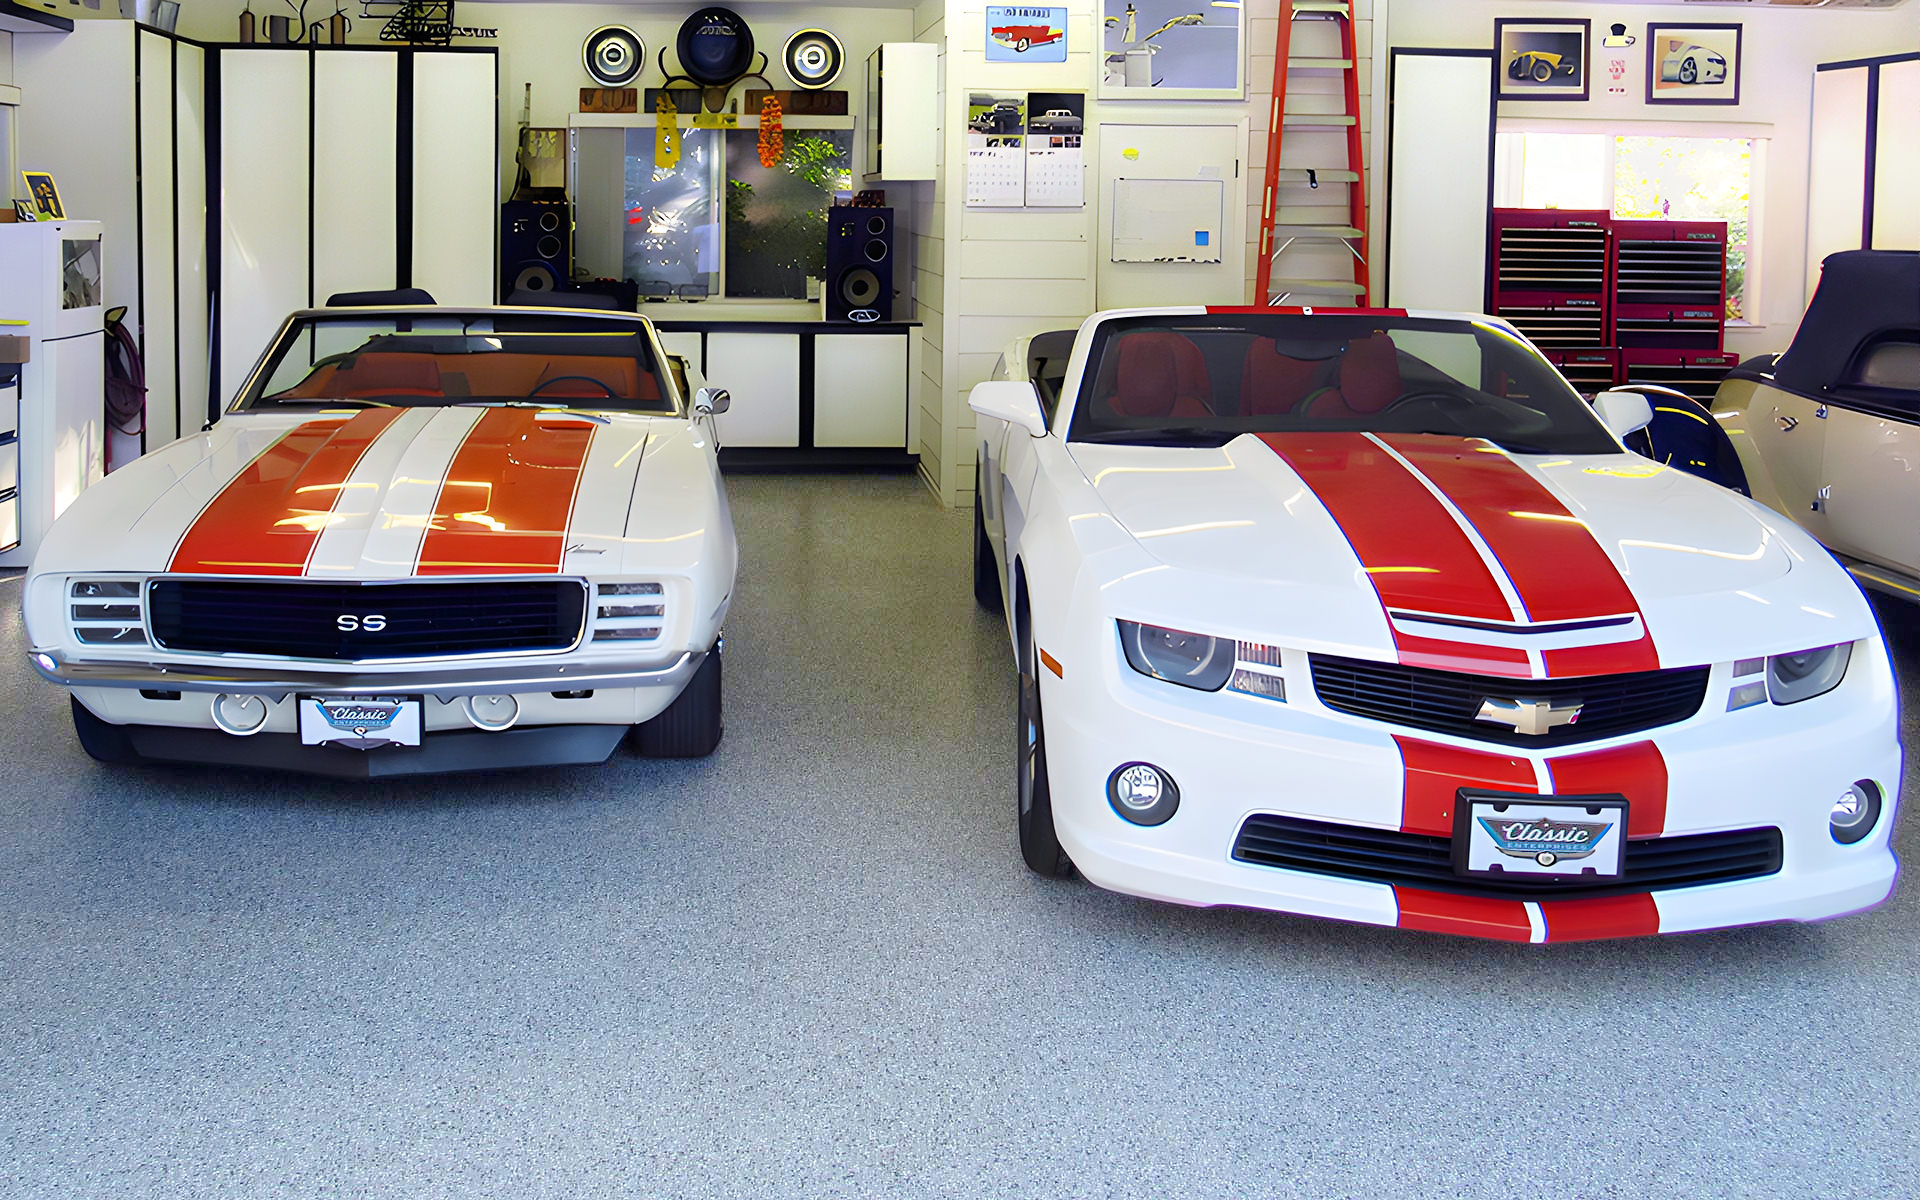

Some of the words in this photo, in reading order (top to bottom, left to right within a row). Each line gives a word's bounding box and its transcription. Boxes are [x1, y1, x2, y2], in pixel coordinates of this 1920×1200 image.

[337, 615, 386, 631] SS
[331, 707, 387, 720] Classic
[1502, 822, 1590, 843] Classic
[1507, 842, 1588, 850] ENTERPRISES
